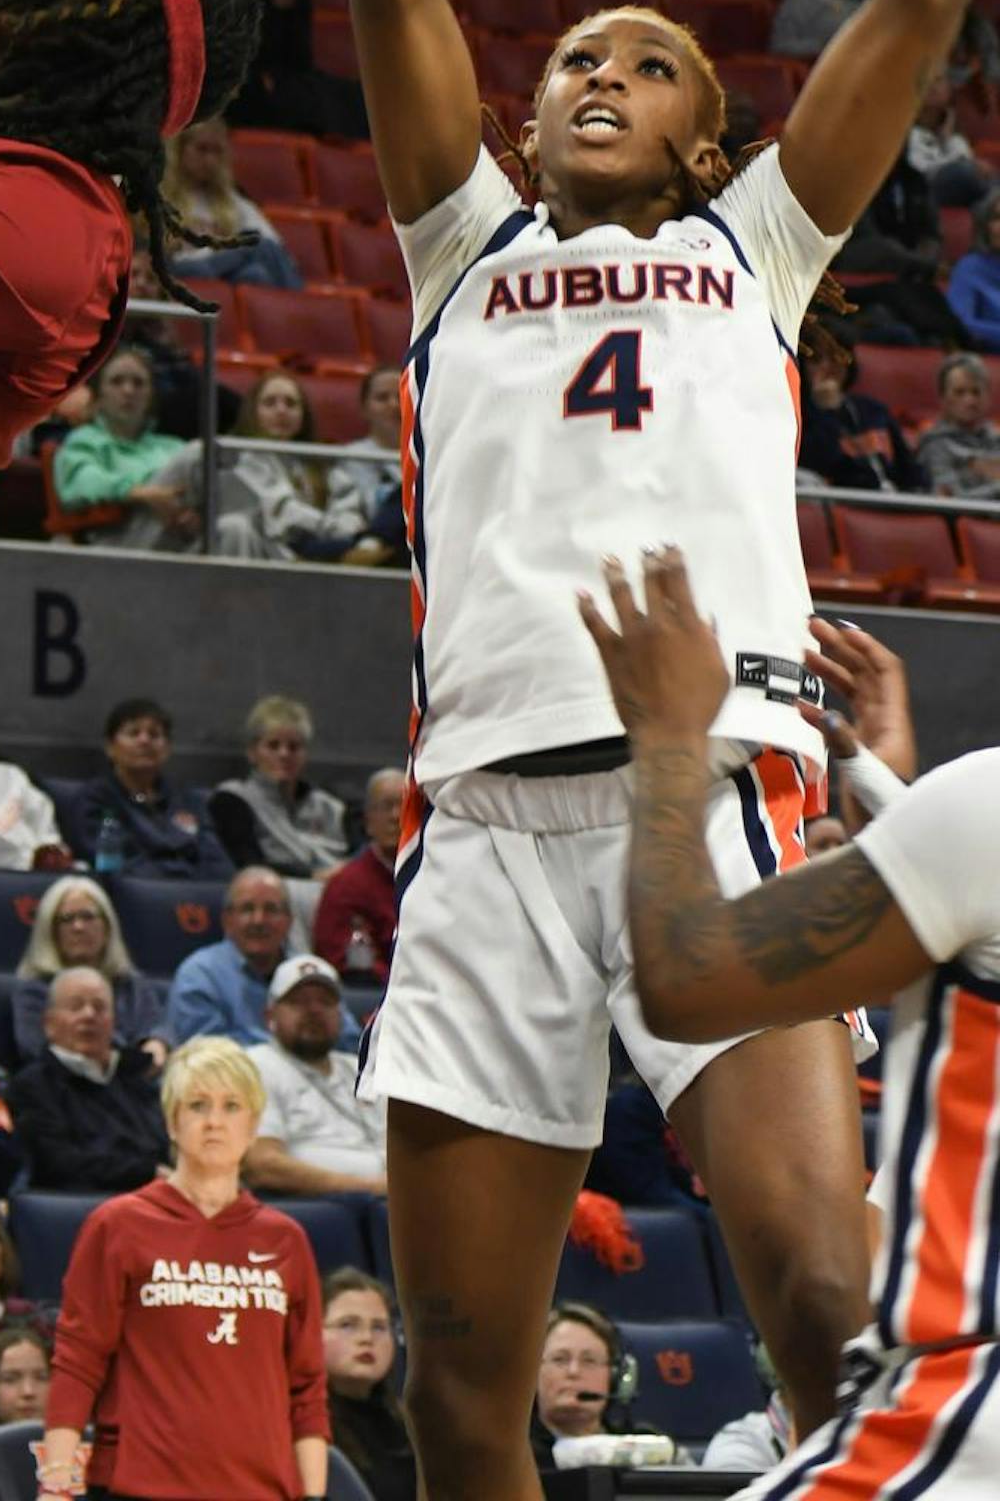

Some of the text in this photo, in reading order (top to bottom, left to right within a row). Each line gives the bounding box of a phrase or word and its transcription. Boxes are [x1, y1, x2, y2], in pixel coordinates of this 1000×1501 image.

[484, 262, 734, 321] AUBURN
[563, 329, 653, 432] 4
[33, 588, 87, 700] B
[139, 1282, 248, 1309] CRIMSON
[152, 1259, 284, 1289] ALABAMA
